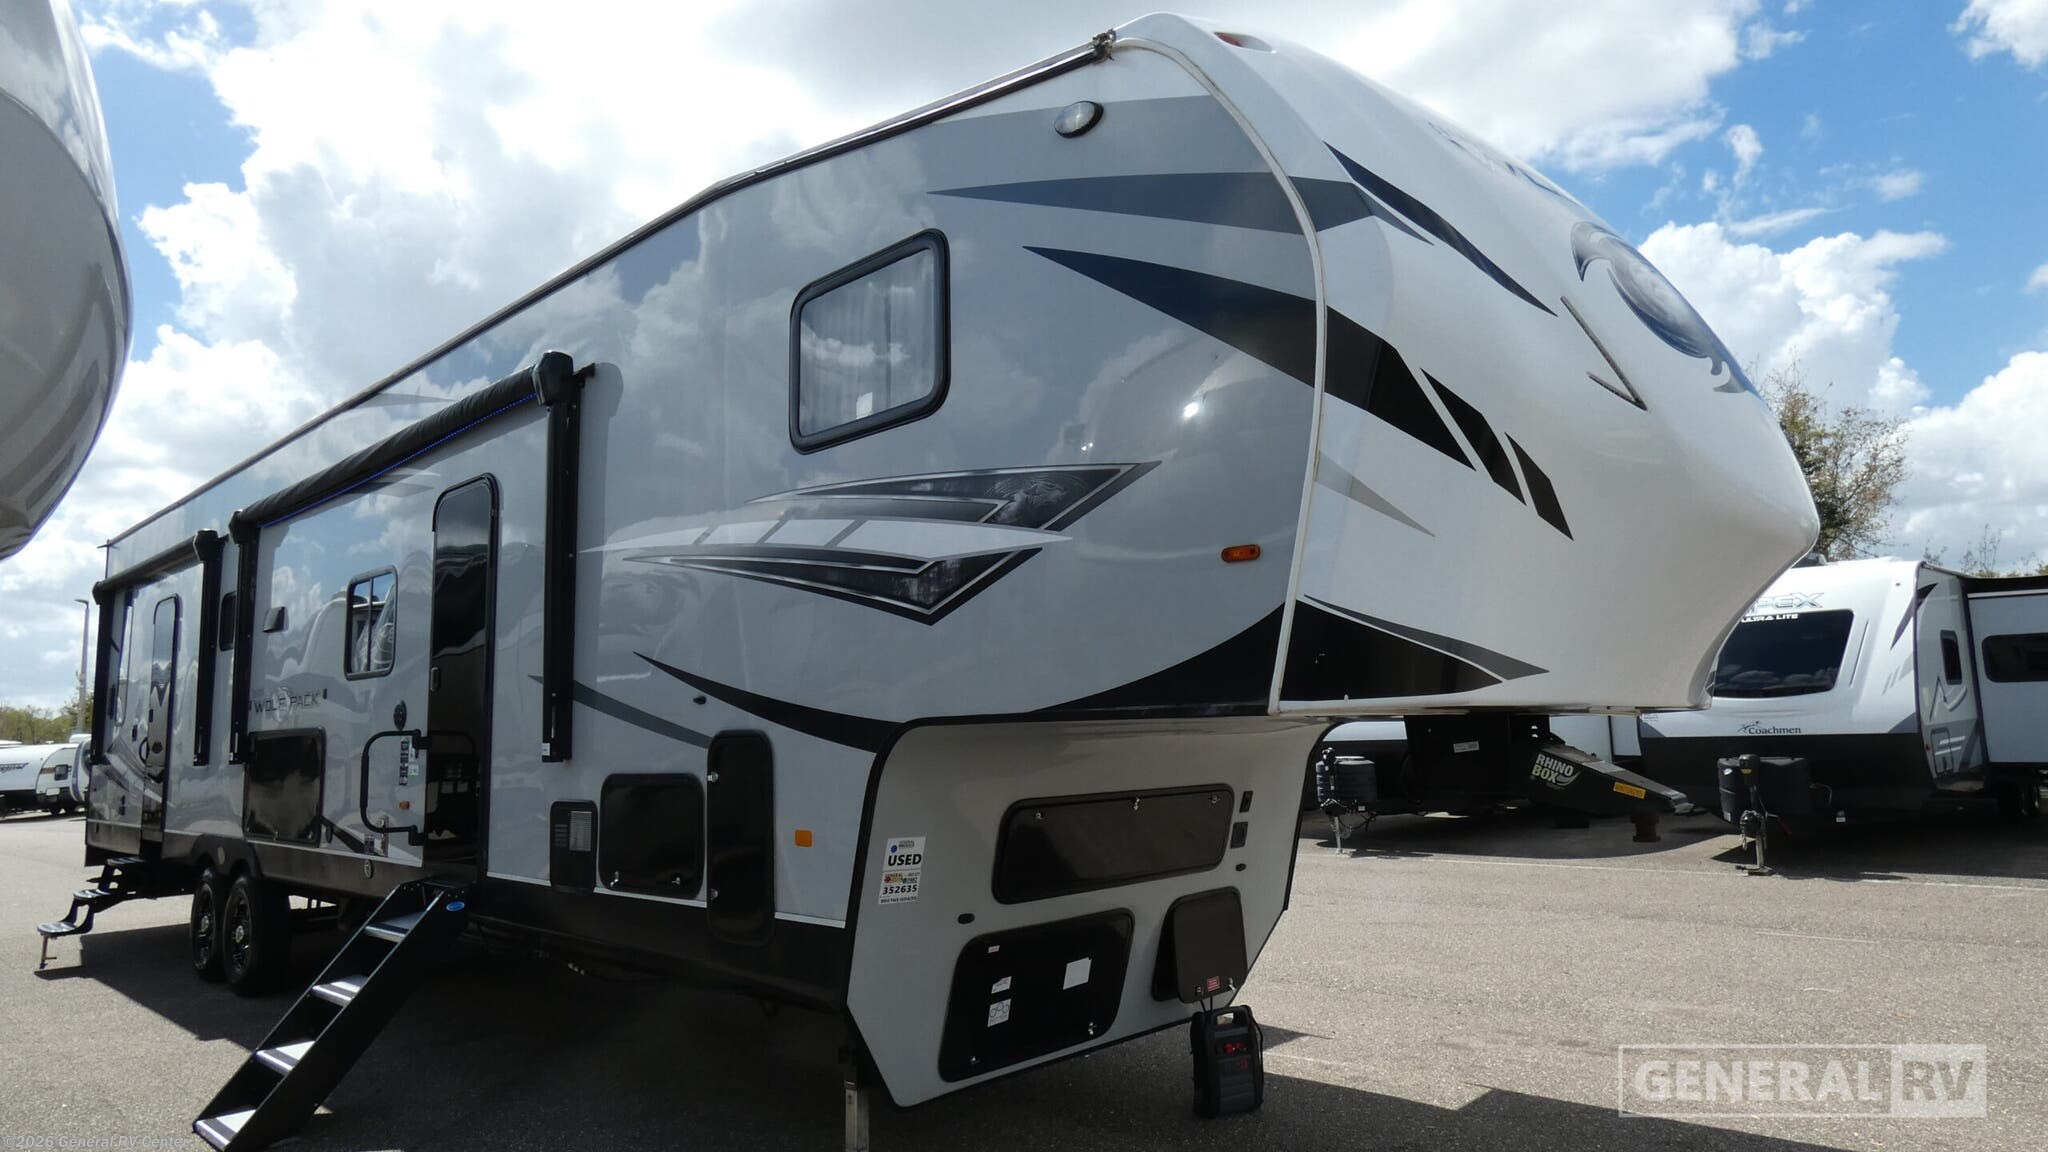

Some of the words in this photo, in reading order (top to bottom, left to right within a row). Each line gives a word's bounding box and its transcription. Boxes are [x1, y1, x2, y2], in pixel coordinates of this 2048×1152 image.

[1741, 615, 1774, 623] ULTRA
[254, 697, 287, 713] WOLF
[289, 692, 319, 708] PACK
[1749, 726, 1802, 735] Coachmen
[1535, 753, 1574, 777] RHINO
[1531, 764, 1559, 784] BOX
[887, 853, 922, 867] USED
[882, 884, 918, 895] 352635
